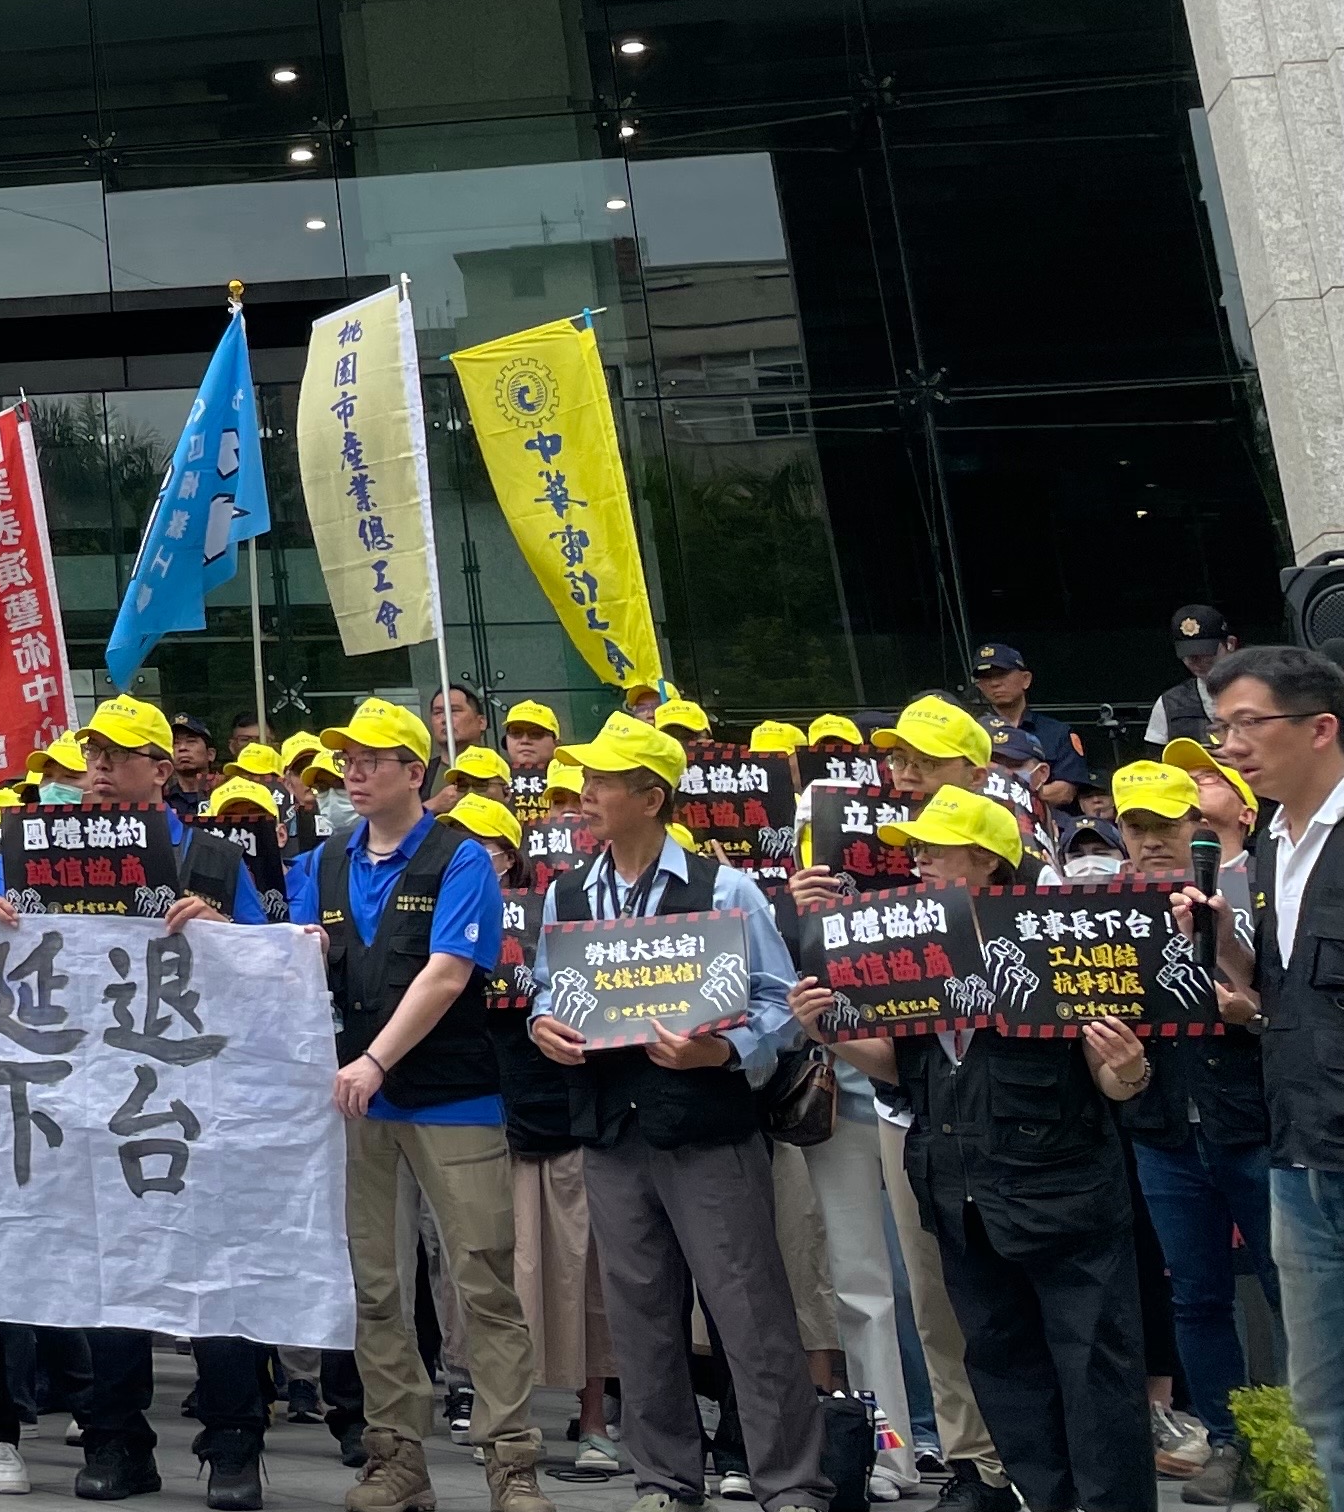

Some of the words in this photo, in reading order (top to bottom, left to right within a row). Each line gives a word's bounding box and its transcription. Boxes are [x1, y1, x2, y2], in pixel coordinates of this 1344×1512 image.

[330, 319, 404, 640] 桃園市產業總工會
[678, 762, 770, 795] 體協約
[826, 756, 883, 787] 立刻
[22, 815, 148, 851] 團體協約
[24, 853, 148, 888] 誠信協商
[821, 898, 948, 951] 團體協約
[1014, 907, 1174, 941] 董事長下台！
[826, 941, 955, 989] 誠信協商
[1047, 943, 1140, 969] 工人團結
[1051, 970, 1146, 997] 抗爭到底
